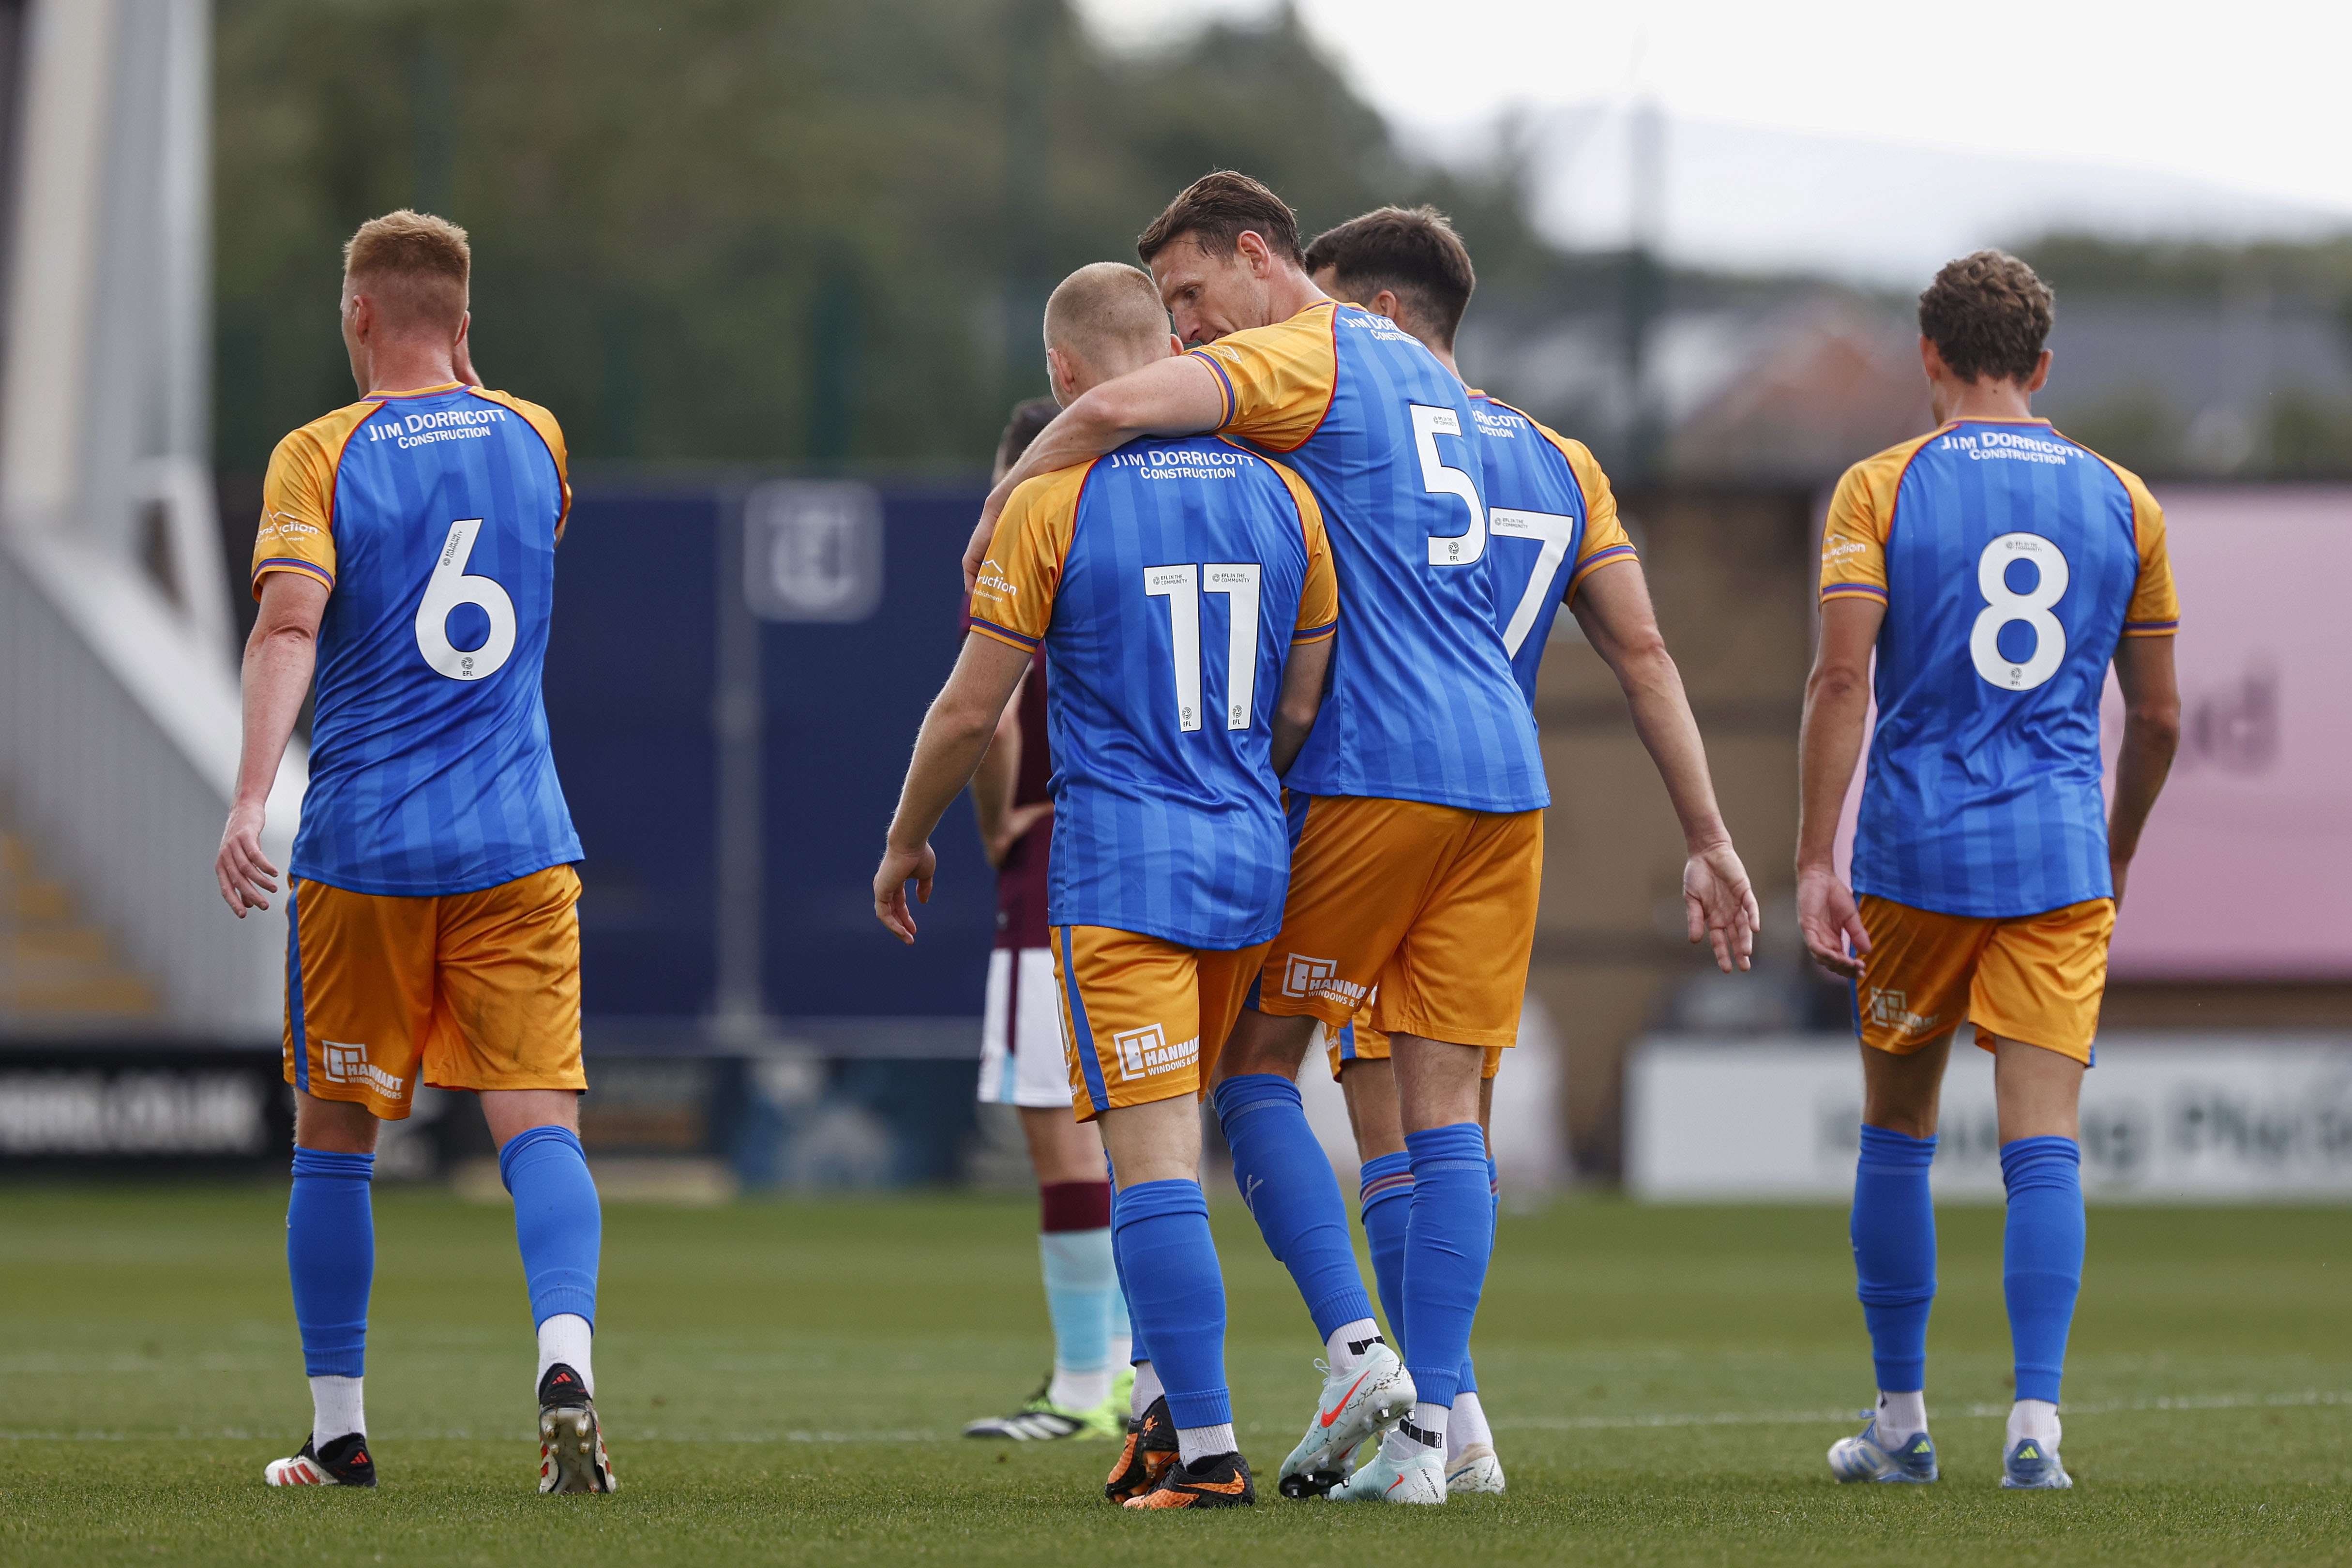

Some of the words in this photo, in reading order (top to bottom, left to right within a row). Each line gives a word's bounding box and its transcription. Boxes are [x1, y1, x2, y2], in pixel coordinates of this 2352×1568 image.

[1341, 317, 1371, 328] JIM
[369, 422, 403, 442] JIM
[405, 409, 506, 433] DORRICOTT
[397, 426, 491, 449] CONSTRUCTION
[1941, 436, 1977, 450] JIM
[1981, 432, 2084, 459] DORRICOTT
[1969, 448, 2066, 465] CONSTRUCTION
[1111, 454, 1146, 468] JIM
[1148, 451, 1254, 467] DORRICOTT
[1140, 467, 1236, 480] CONSTRUCTION
[1409, 404, 1486, 566] 5
[1490, 507, 1573, 661] 7
[415, 519, 516, 680] 6
[1970, 532, 2070, 691] 8
[1143, 563, 1261, 732] 11
[1308, 990, 1348, 1005] WINDOWS
[1349, 999, 1355, 1008] &
[1144, 1035, 1199, 1067] HANMAR
[1148, 1059, 1186, 1076] WINDOWS
